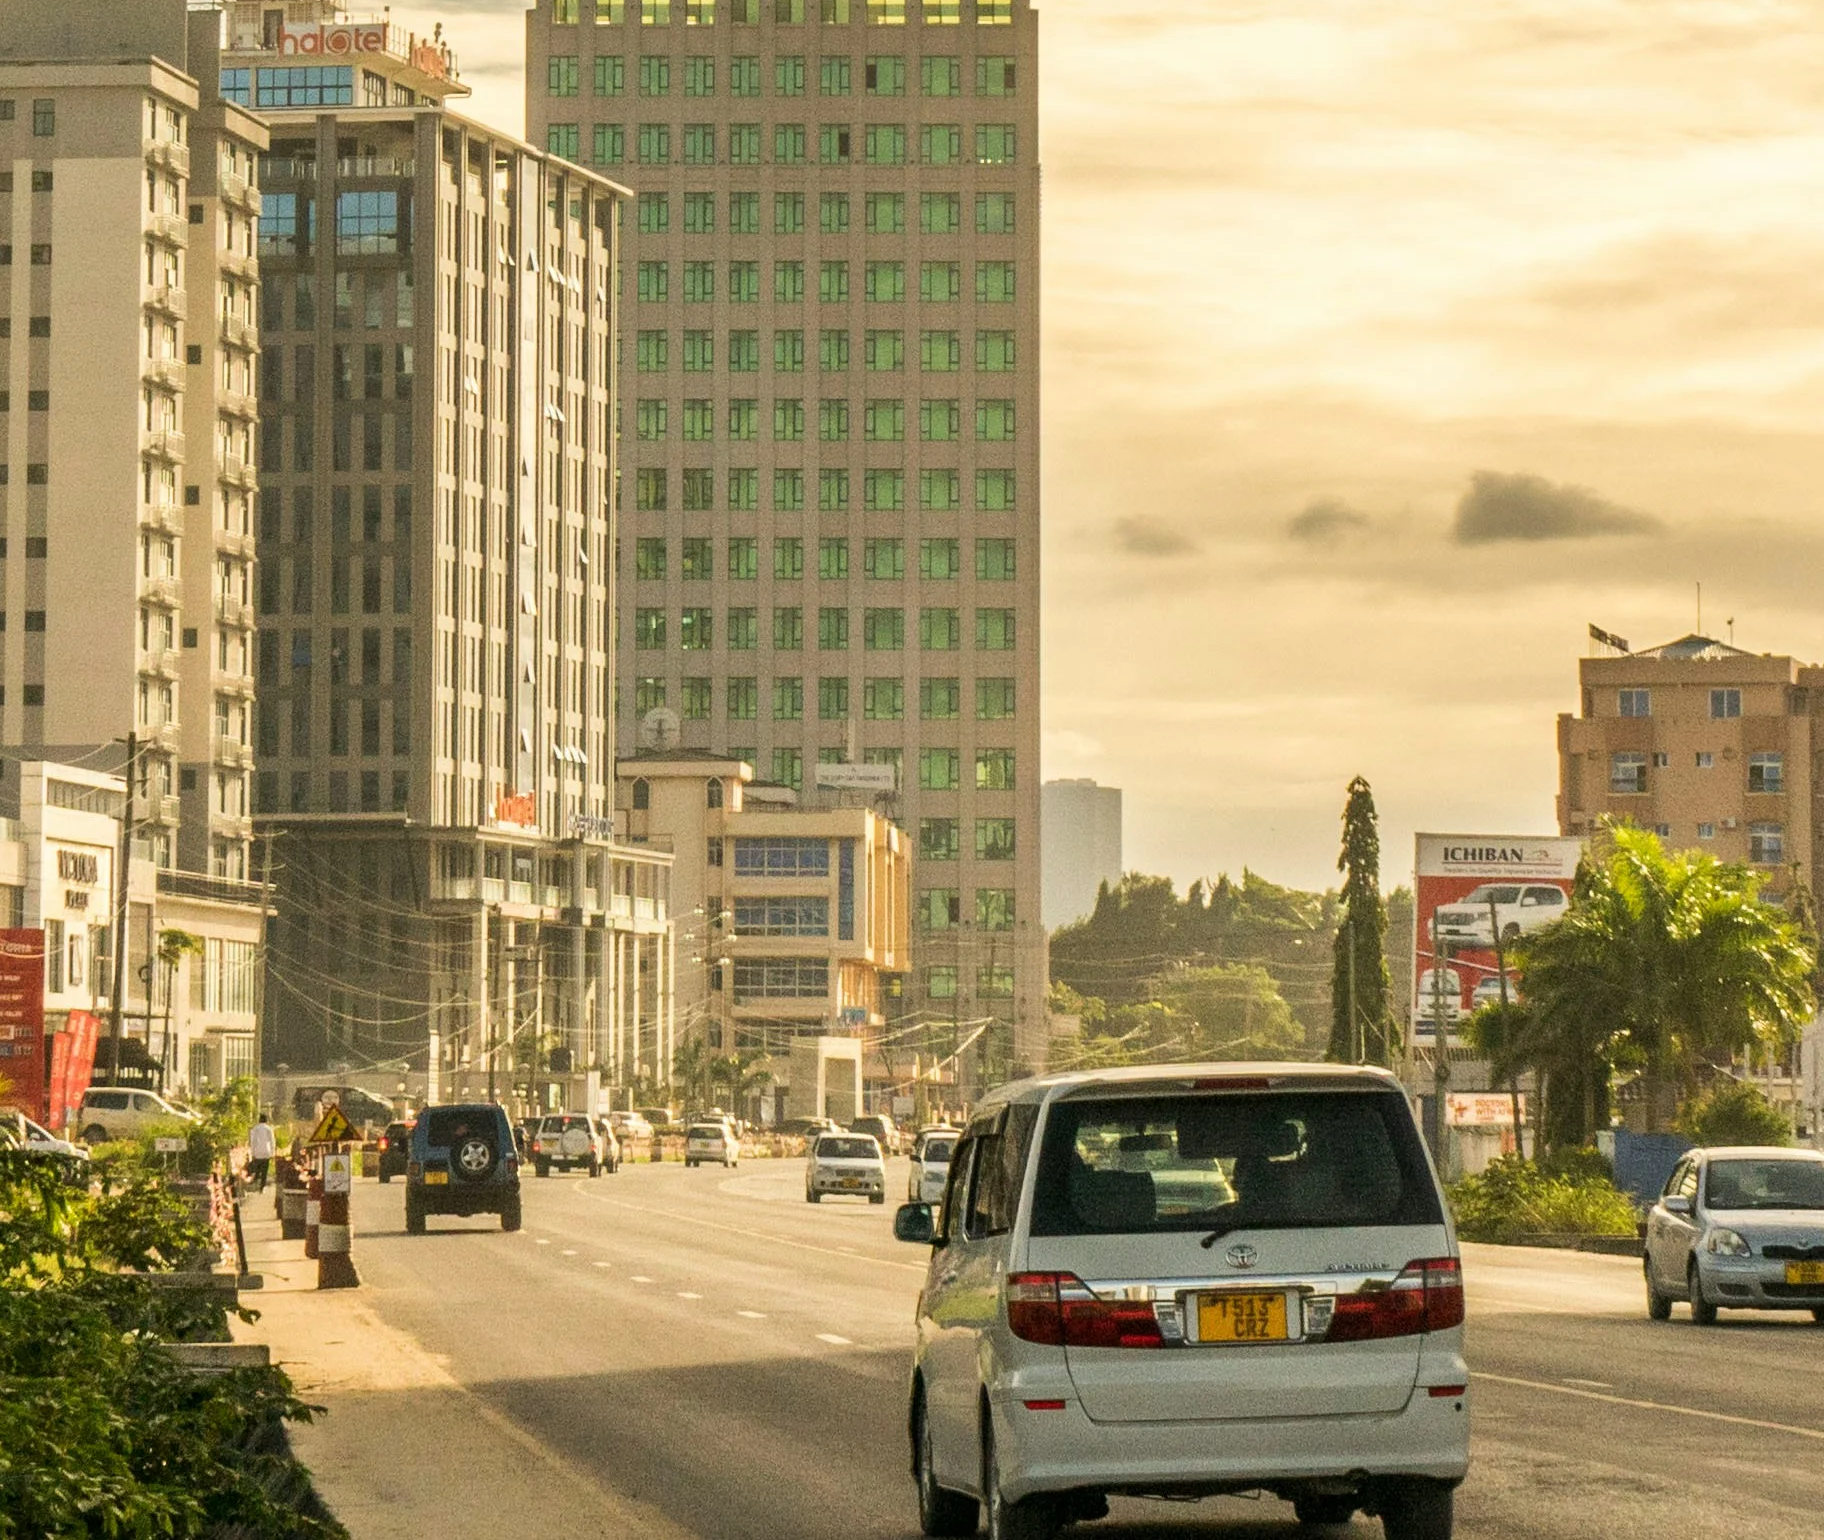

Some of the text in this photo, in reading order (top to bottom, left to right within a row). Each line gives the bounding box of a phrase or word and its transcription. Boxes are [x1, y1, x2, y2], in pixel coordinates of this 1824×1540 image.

[278, 22, 387, 56] halotel
[1443, 847, 1524, 861] ICHIBAN
[1234, 1318, 1271, 1338] CRZ
